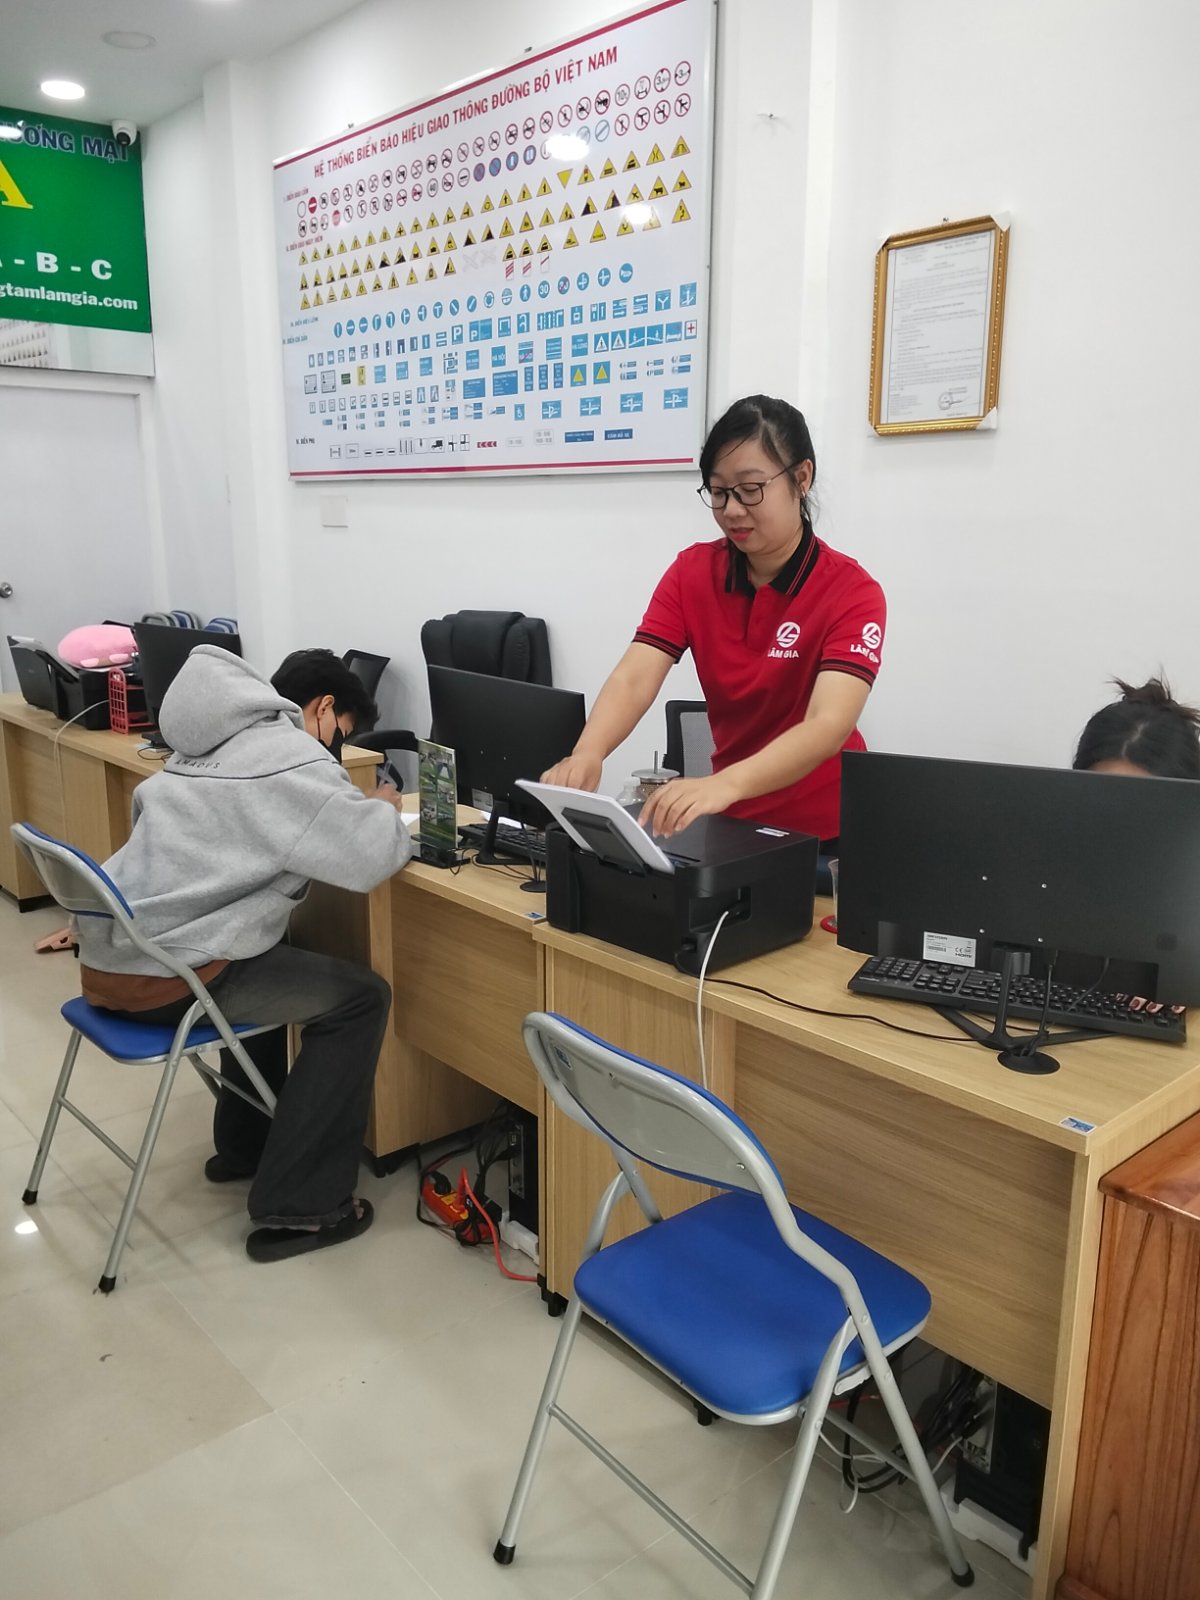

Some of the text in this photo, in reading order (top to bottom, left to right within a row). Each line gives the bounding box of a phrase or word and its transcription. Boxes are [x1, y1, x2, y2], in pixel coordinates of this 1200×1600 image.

[427, 113, 450, 135] GIAO
[453, 100, 488, 124] THÔNG
[492, 81, 530, 110] ĐƯỜNG
[534, 69, 550, 93] BỘ
[555, 59, 583, 84] VIỆT
[588, 46, 617, 72] NAM
[36, 251, 59, 273] B
[91, 259, 112, 280] C
[453, 327, 462, 340] P
